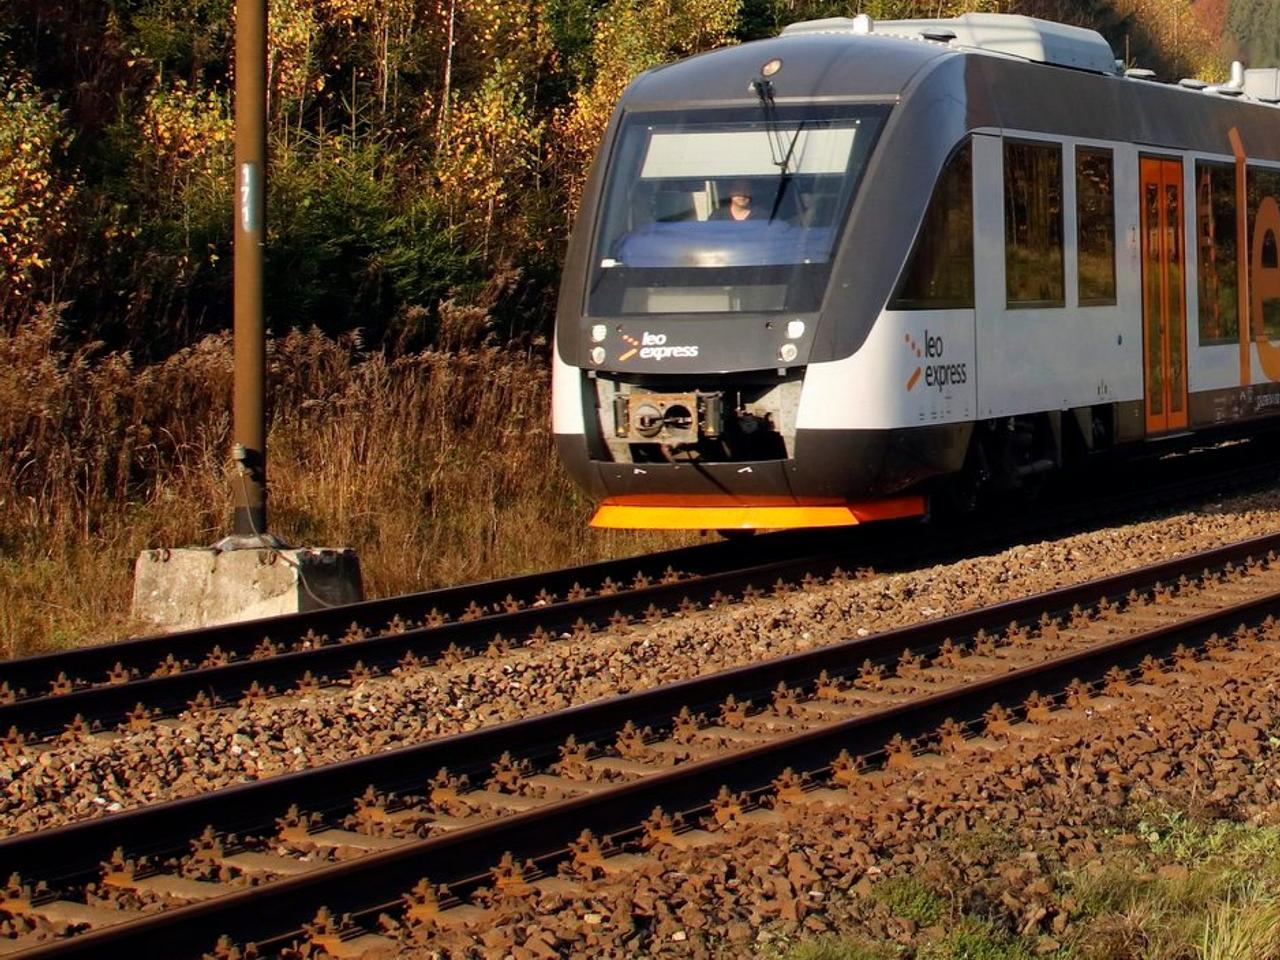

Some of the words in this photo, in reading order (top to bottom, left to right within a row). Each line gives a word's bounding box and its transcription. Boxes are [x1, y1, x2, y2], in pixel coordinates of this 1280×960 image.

[642, 332, 667, 345] leo
[925, 328, 943, 358] leo
[639, 346, 699, 360] express
[925, 363, 967, 393] express
